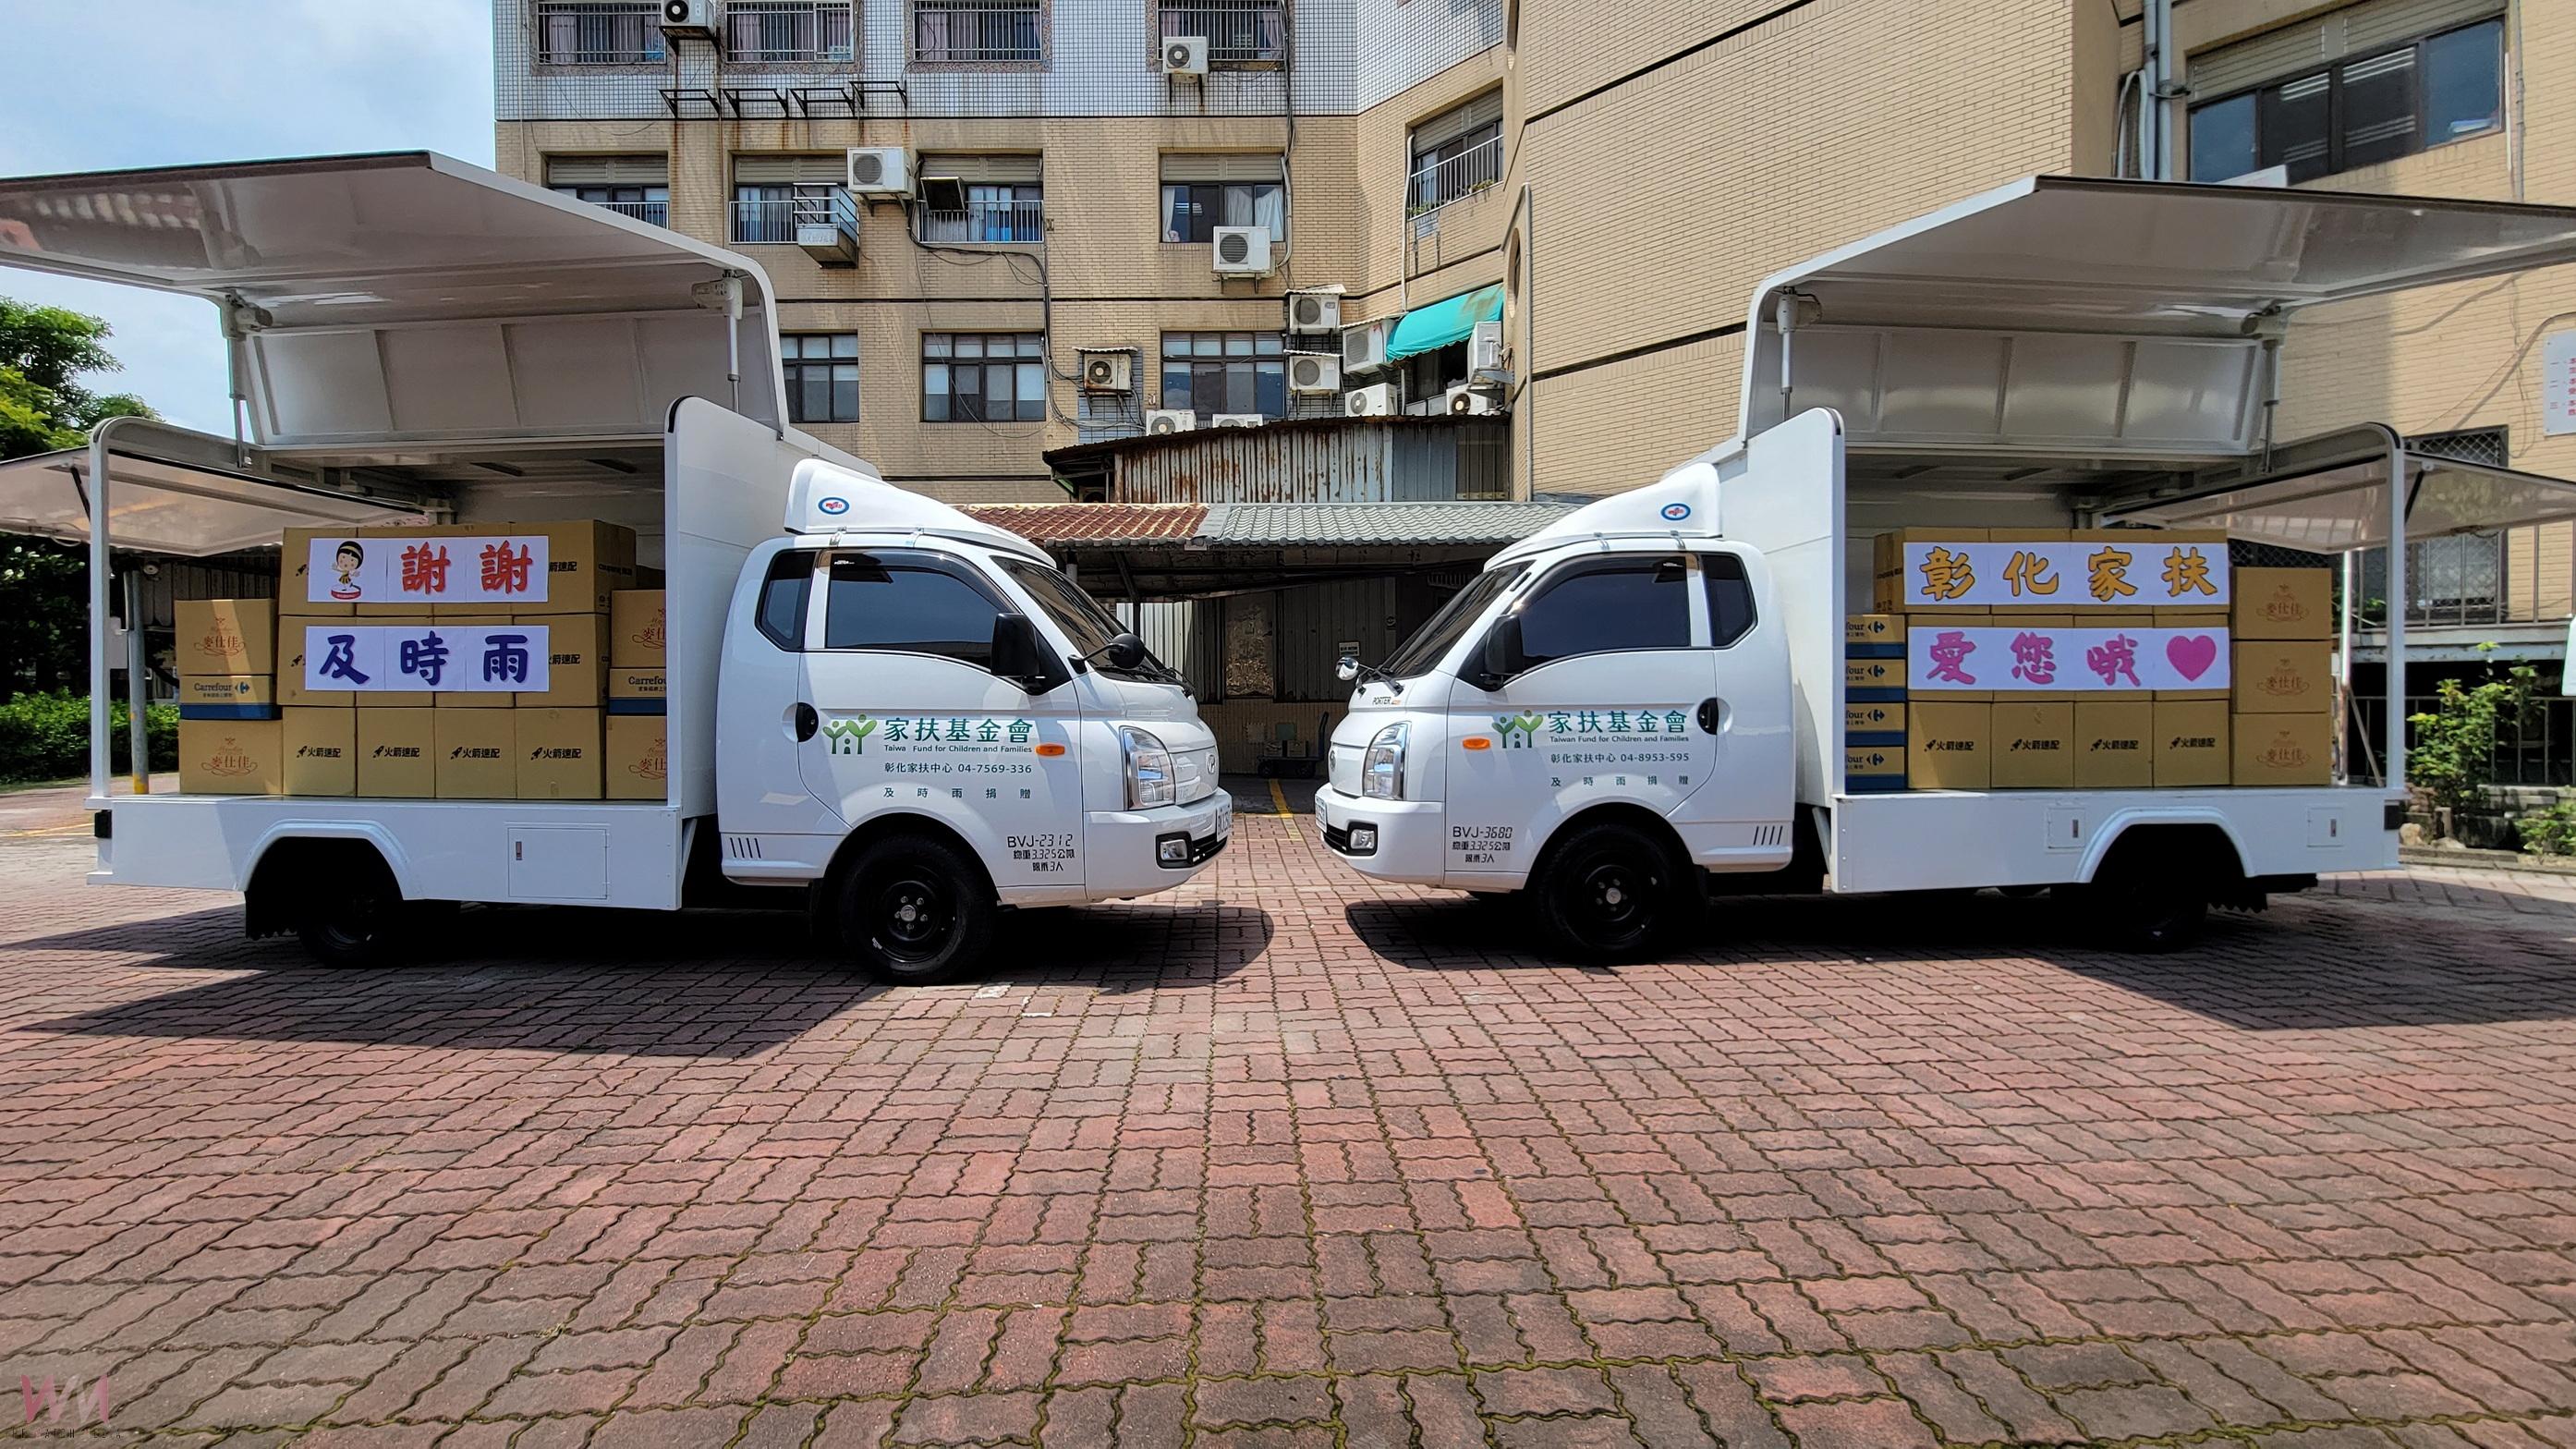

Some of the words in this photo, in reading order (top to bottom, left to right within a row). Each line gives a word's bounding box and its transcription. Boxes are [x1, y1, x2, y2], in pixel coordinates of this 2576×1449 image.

[401, 540, 533, 594] 謝謝
[1920, 546, 2218, 601] 彰化家扶
[320, 630, 528, 686] 及時雨
[1926, 631, 2141, 687] 愛您哦
[194, 682, 232, 691] Carrefour
[1548, 710, 1687, 733] 家扶基金會
[884, 718, 1033, 743] 家扶基金會
[1550, 753, 1616, 763] 彰化家扶中心
[1620, 752, 1690, 762] 04-8953-595
[884, 762, 953, 773] 彰化家扶中心
[958, 763, 1032, 773] 04-7569-336
[1550, 775, 1688, 786] 及時雨捐贈
[883, 787, 1031, 798] 及時雨捐贈
[1452, 826, 1513, 838] BVJ-3680
[1007, 834, 1073, 847] BVJ-2312
